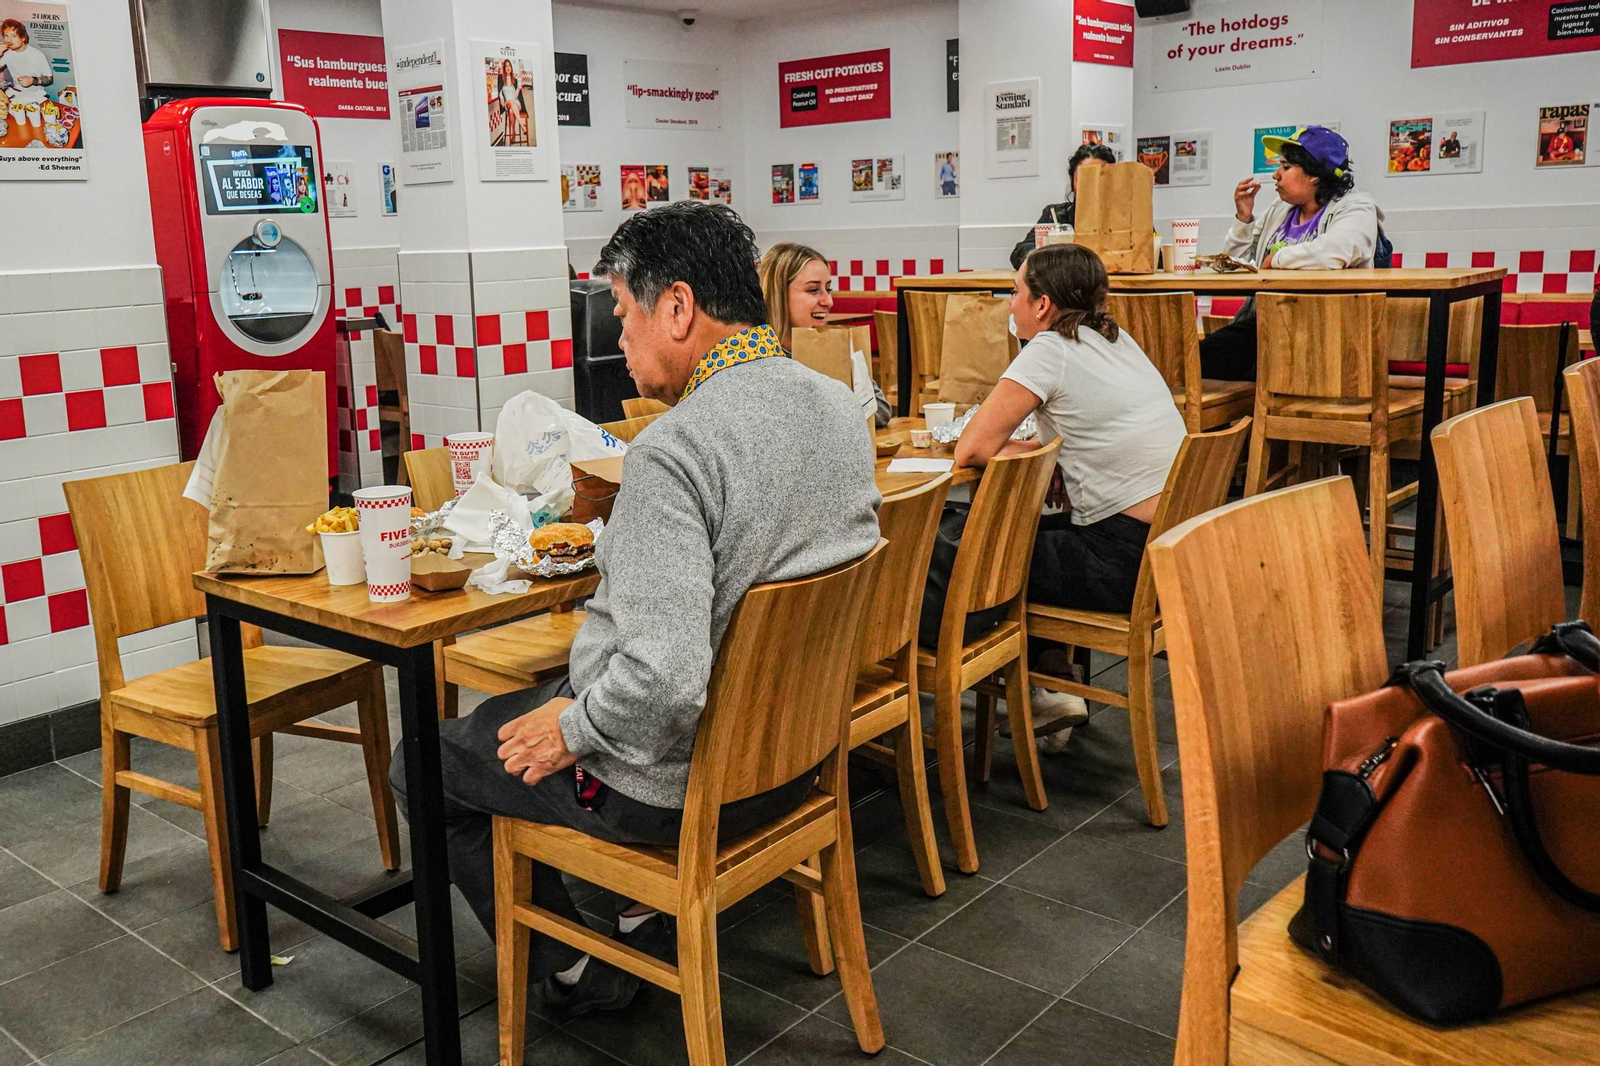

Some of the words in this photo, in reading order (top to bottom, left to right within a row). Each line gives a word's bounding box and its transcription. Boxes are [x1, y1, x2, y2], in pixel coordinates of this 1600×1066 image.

[1551, 5, 1587, 14] Cocinamos
[1182, 21, 1216, 37] “The
[1221, 14, 1289, 33] hotdogs
[1449, 23, 1465, 32] SIN
[1466, 18, 1510, 30] ADITIVOS
[1562, 21, 1584, 29] jugosa
[1434, 36, 1450, 45] SIN
[1452, 28, 1524, 43] CONSERVANTES
[1556, 27, 1595, 36] bien-hecha
[1167, 44, 1184, 60] of
[1187, 43, 1226, 61] your
[1230, 33, 1304, 53] dreams.”
[287, 55, 314, 68] “Sus
[784, 70, 814, 83] FRESH
[814, 68, 834, 79] CUT
[835, 61, 884, 77] POTATOES
[308, 75, 364, 88] realmente
[572, 74, 586, 84] su
[627, 84, 694, 101] “lip-smackingly
[694, 90, 719, 102] good”
[834, 83, 878, 94] PRESERVATIVES
[792, 91, 810, 99] Cooked
[996, 93, 1026, 102] Evening
[996, 99, 1030, 110] Standard
[222, 178, 234, 189] AL
[235, 178, 265, 190] SABOR
[226, 191, 238, 200] QUE
[240, 190, 262, 198] DESEAS
[380, 529, 407, 542] FIVE
